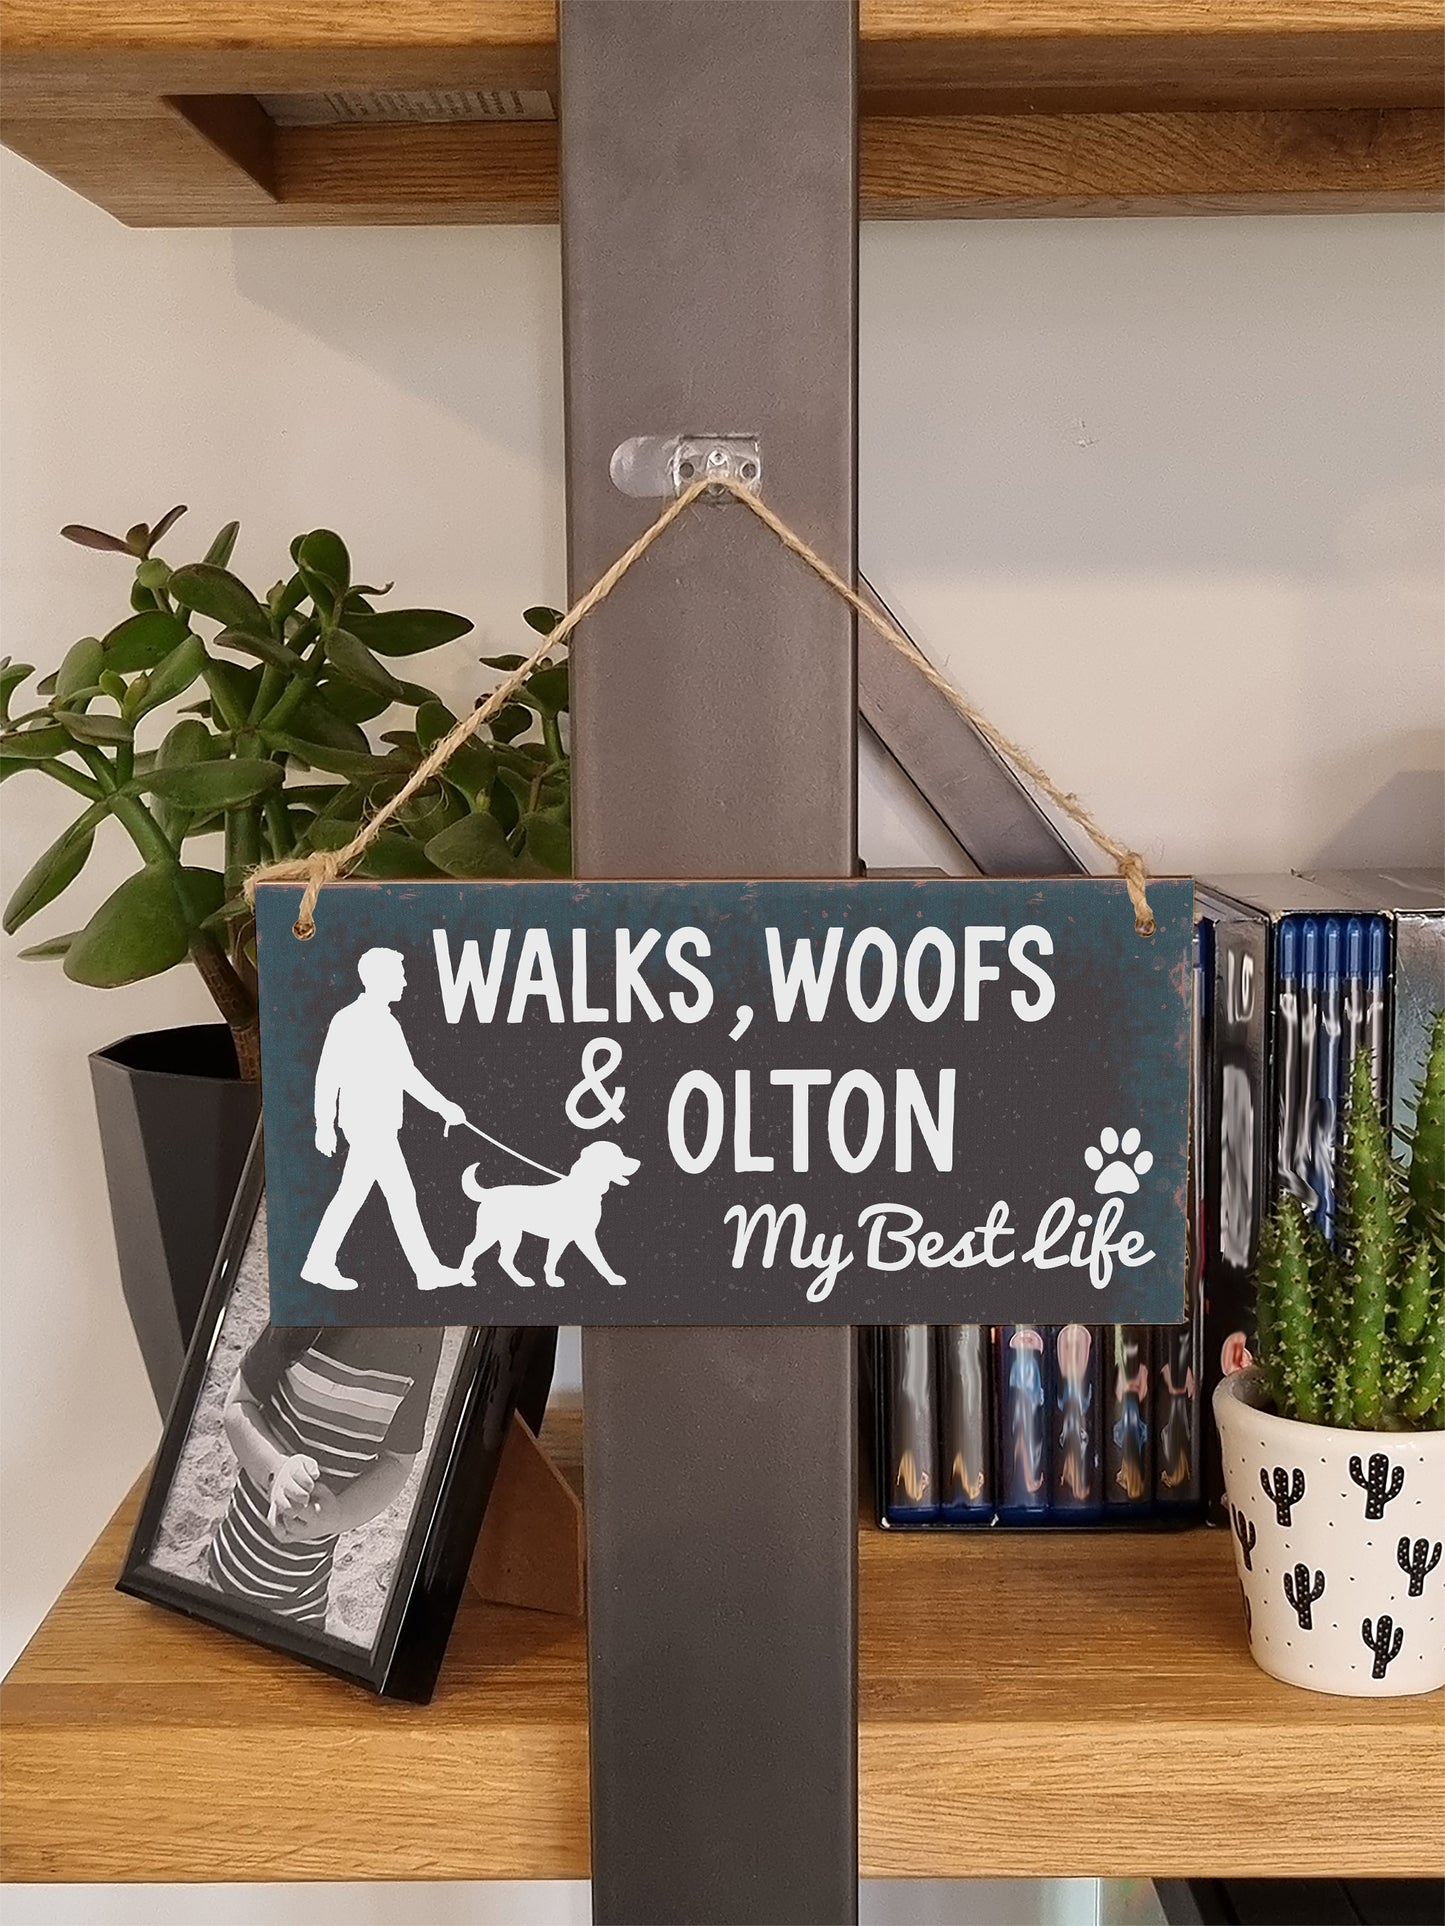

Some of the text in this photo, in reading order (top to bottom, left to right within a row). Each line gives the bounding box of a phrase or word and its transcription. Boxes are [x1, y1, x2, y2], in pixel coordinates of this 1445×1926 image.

[565, 1037, 956, 1174] & OLTON
[723, 1204, 854, 1303] My
[858, 1201, 1015, 1271] Best
